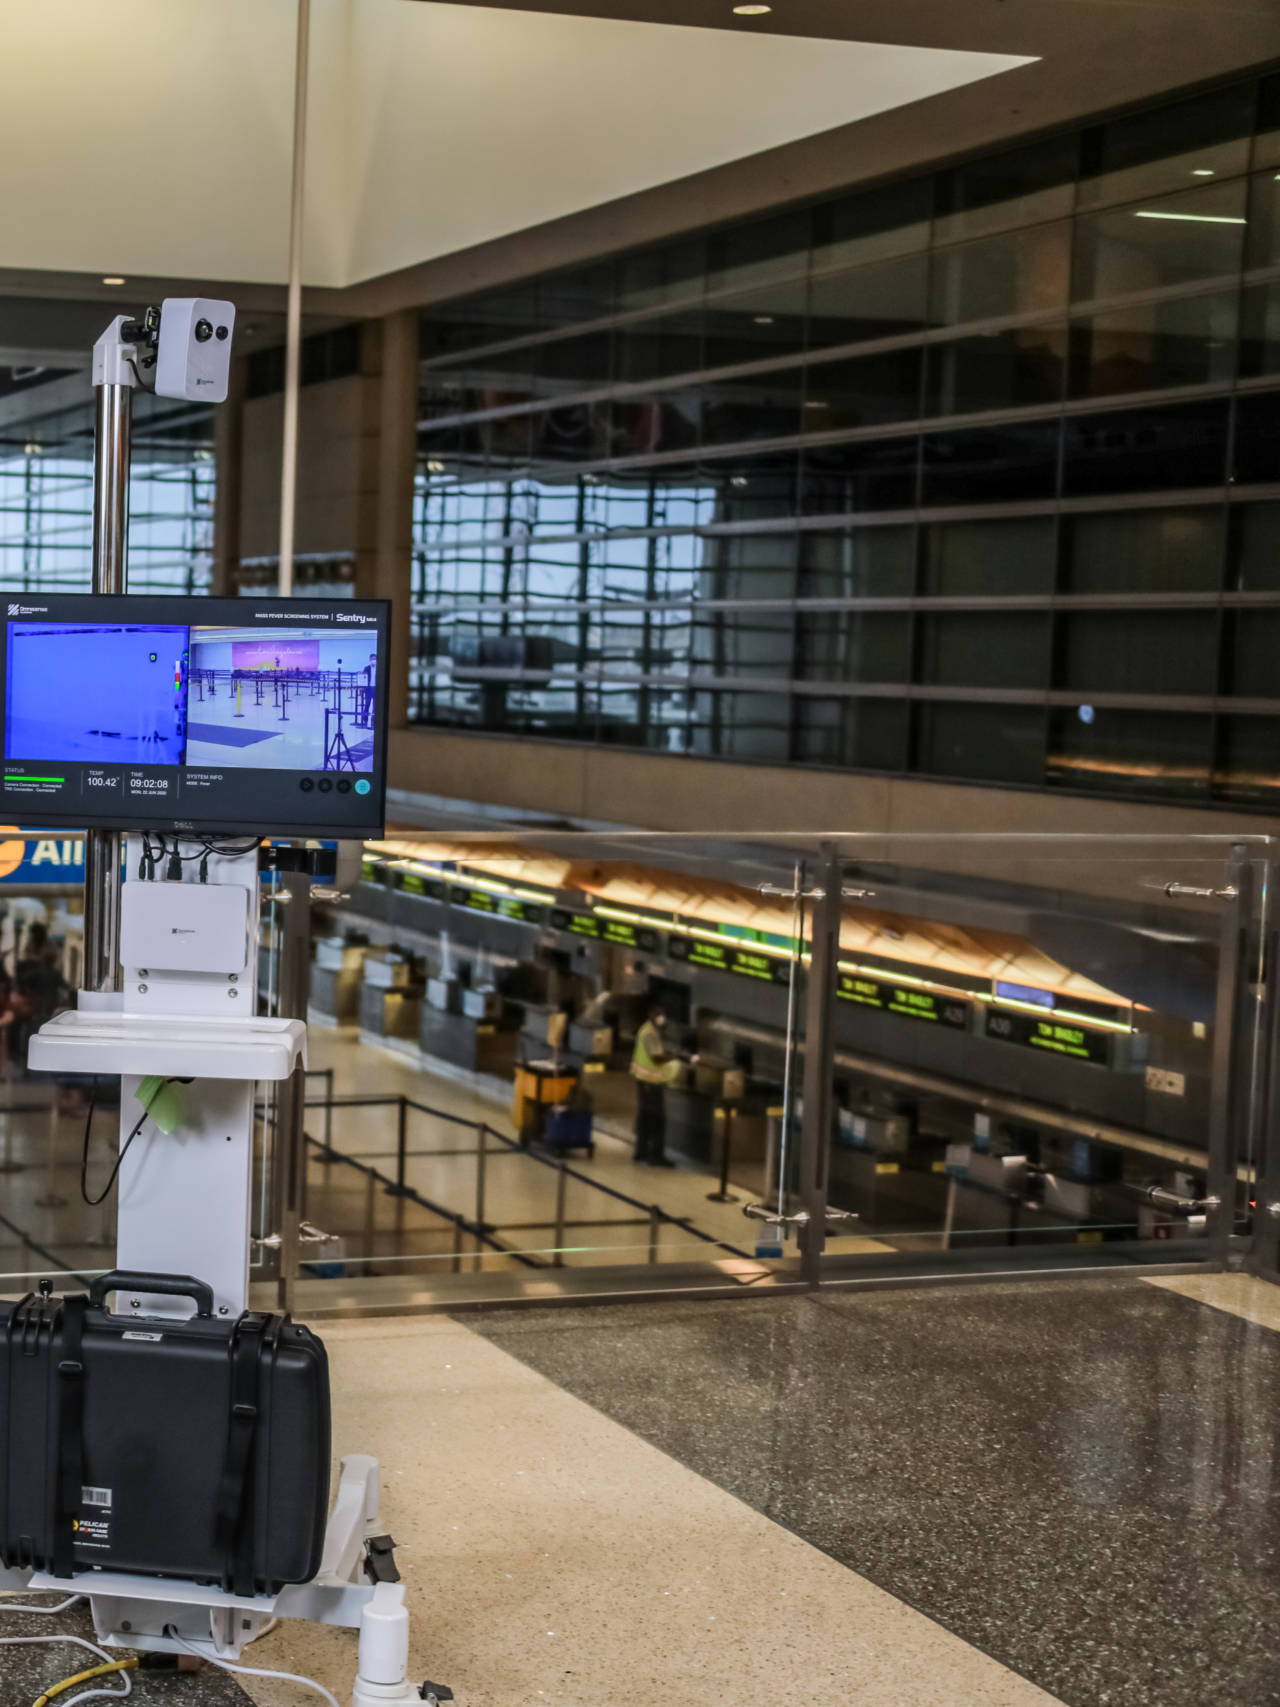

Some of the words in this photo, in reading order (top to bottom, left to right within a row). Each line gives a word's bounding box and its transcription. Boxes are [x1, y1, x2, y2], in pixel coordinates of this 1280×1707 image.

[336, 613, 366, 623] Sentry
[130, 779, 168, 788] 09:02:08
[80, 1520, 109, 1528] PELICAN
